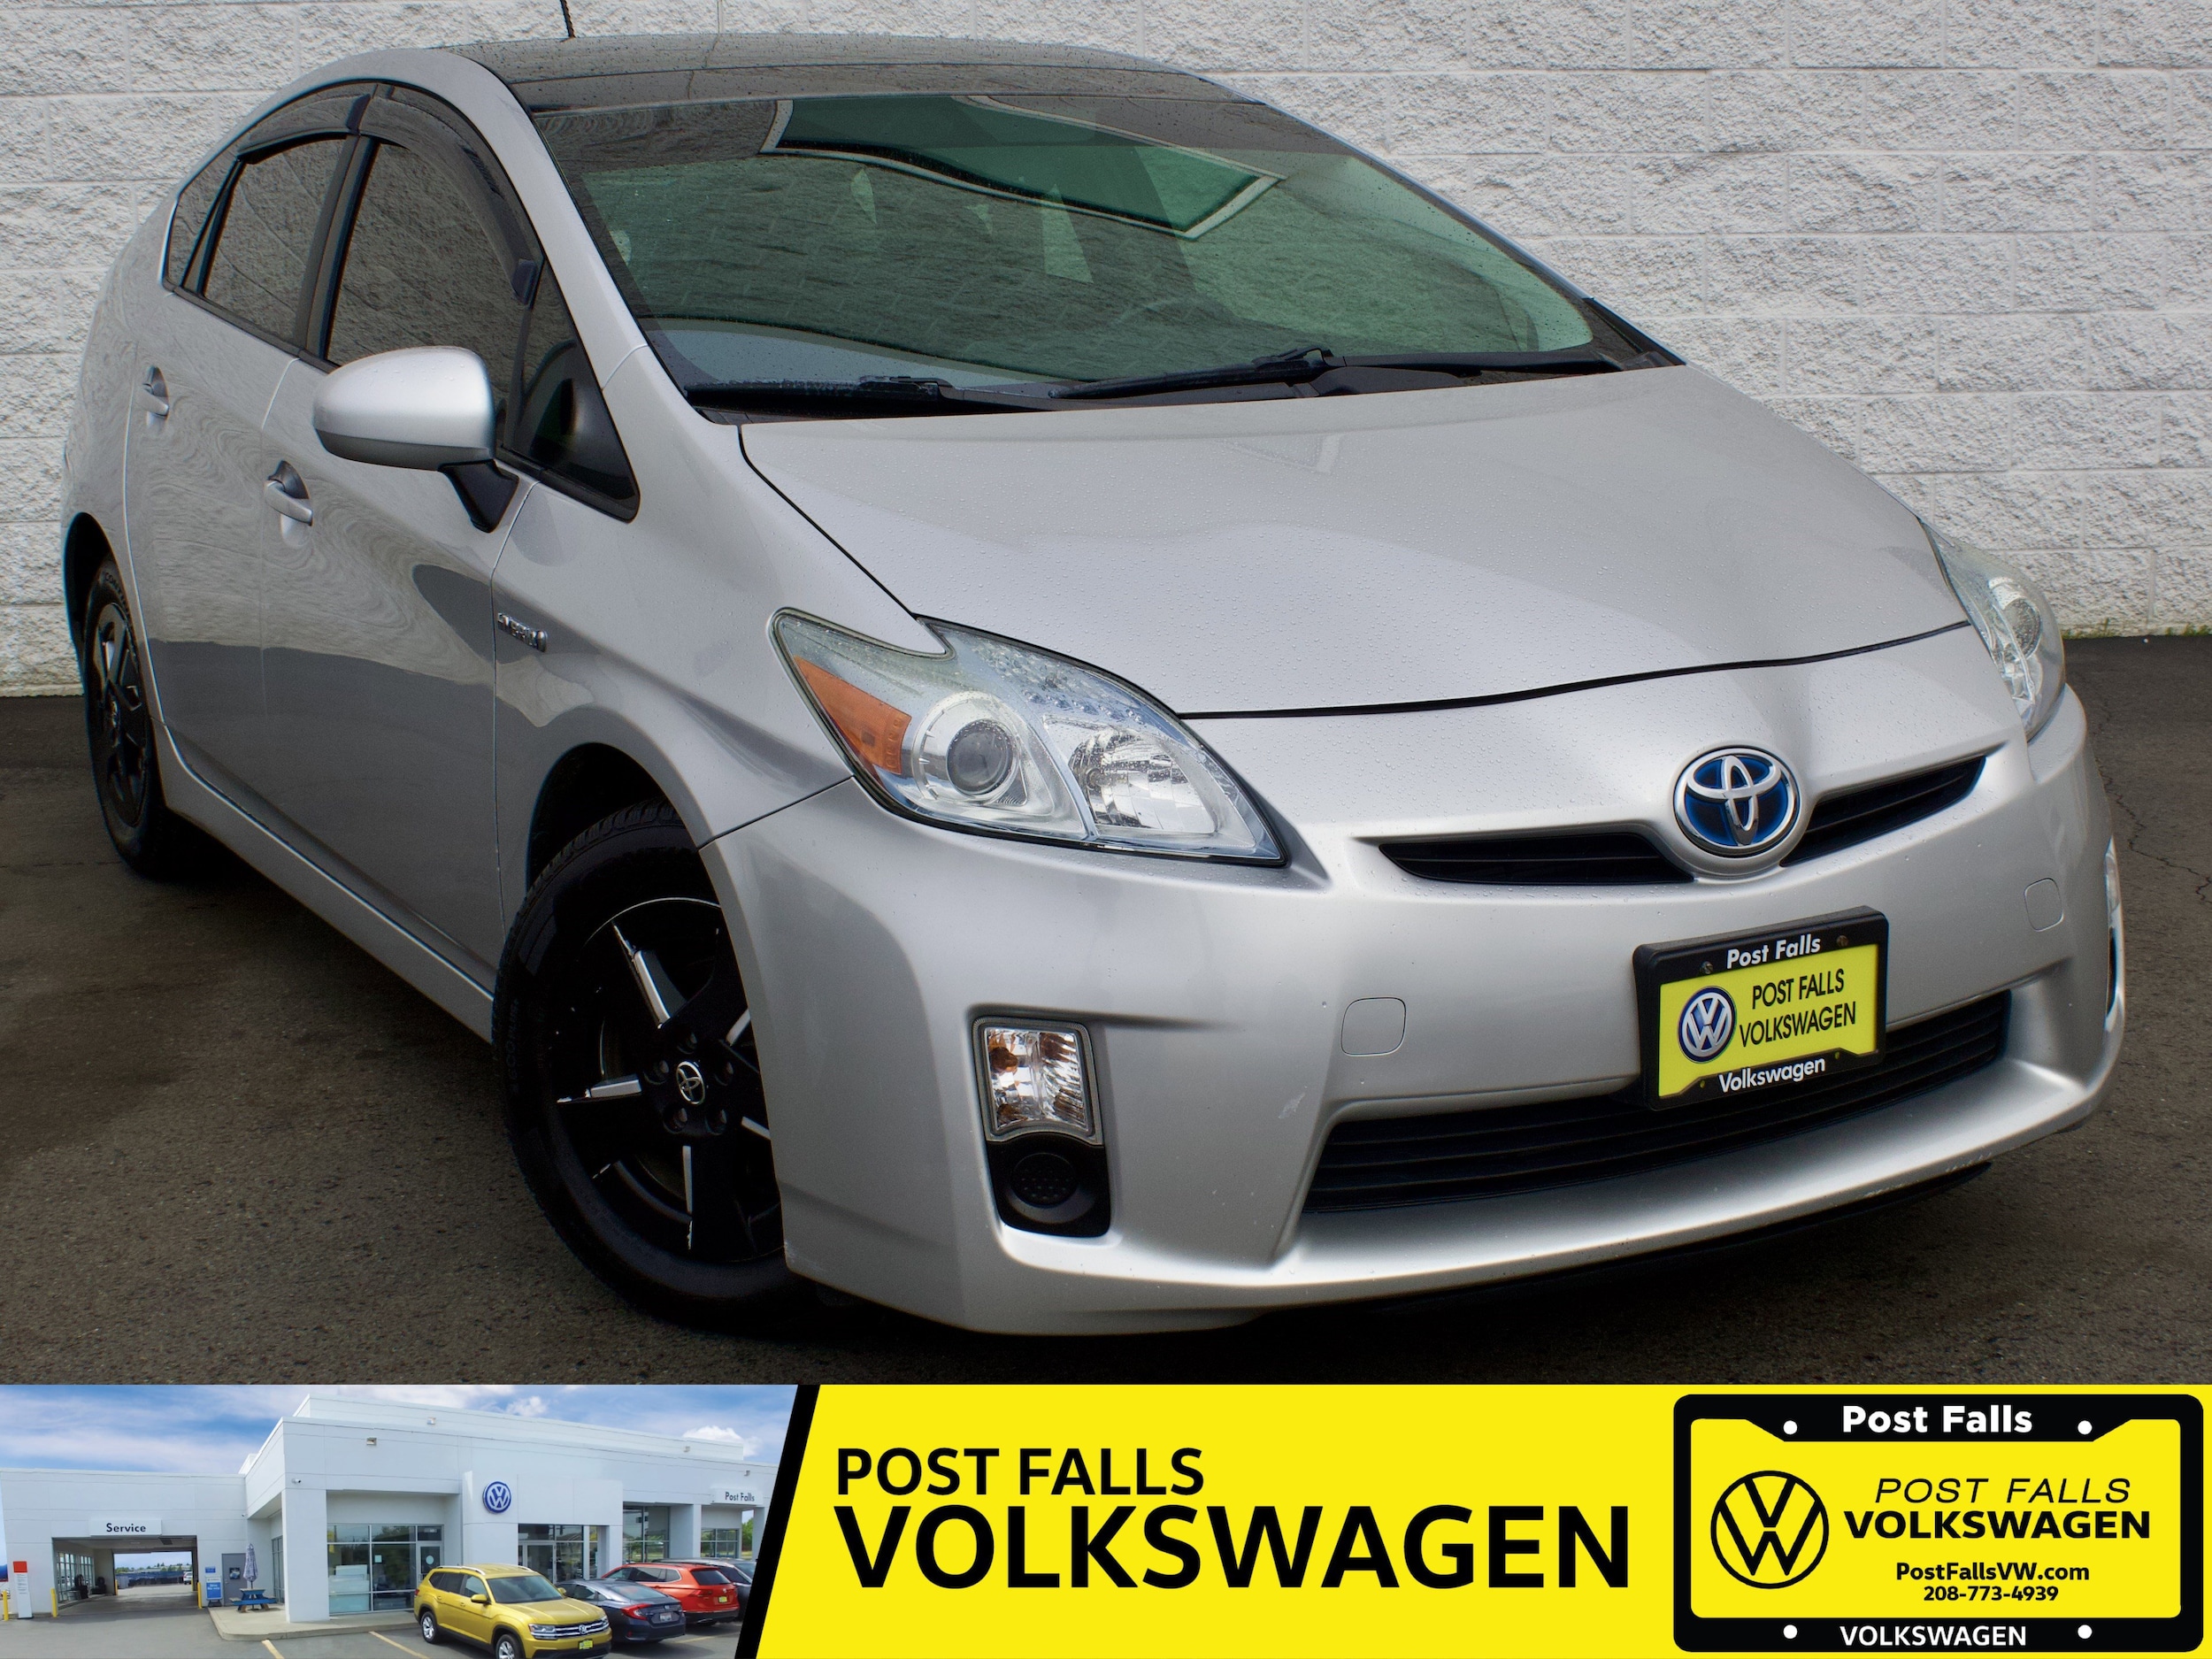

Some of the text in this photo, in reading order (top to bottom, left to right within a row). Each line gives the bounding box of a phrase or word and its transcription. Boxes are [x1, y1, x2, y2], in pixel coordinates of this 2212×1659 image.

[1726, 933, 1821, 970] Post Falls
[1752, 968, 1845, 1010] POST FALLS
[1739, 1001, 1856, 1048] VOLKSWAGEN
[1718, 1057, 1825, 1093] Volkswagen
[725, 1491, 755, 1502] Post Falls
[105, 1522, 147, 1532] Service
